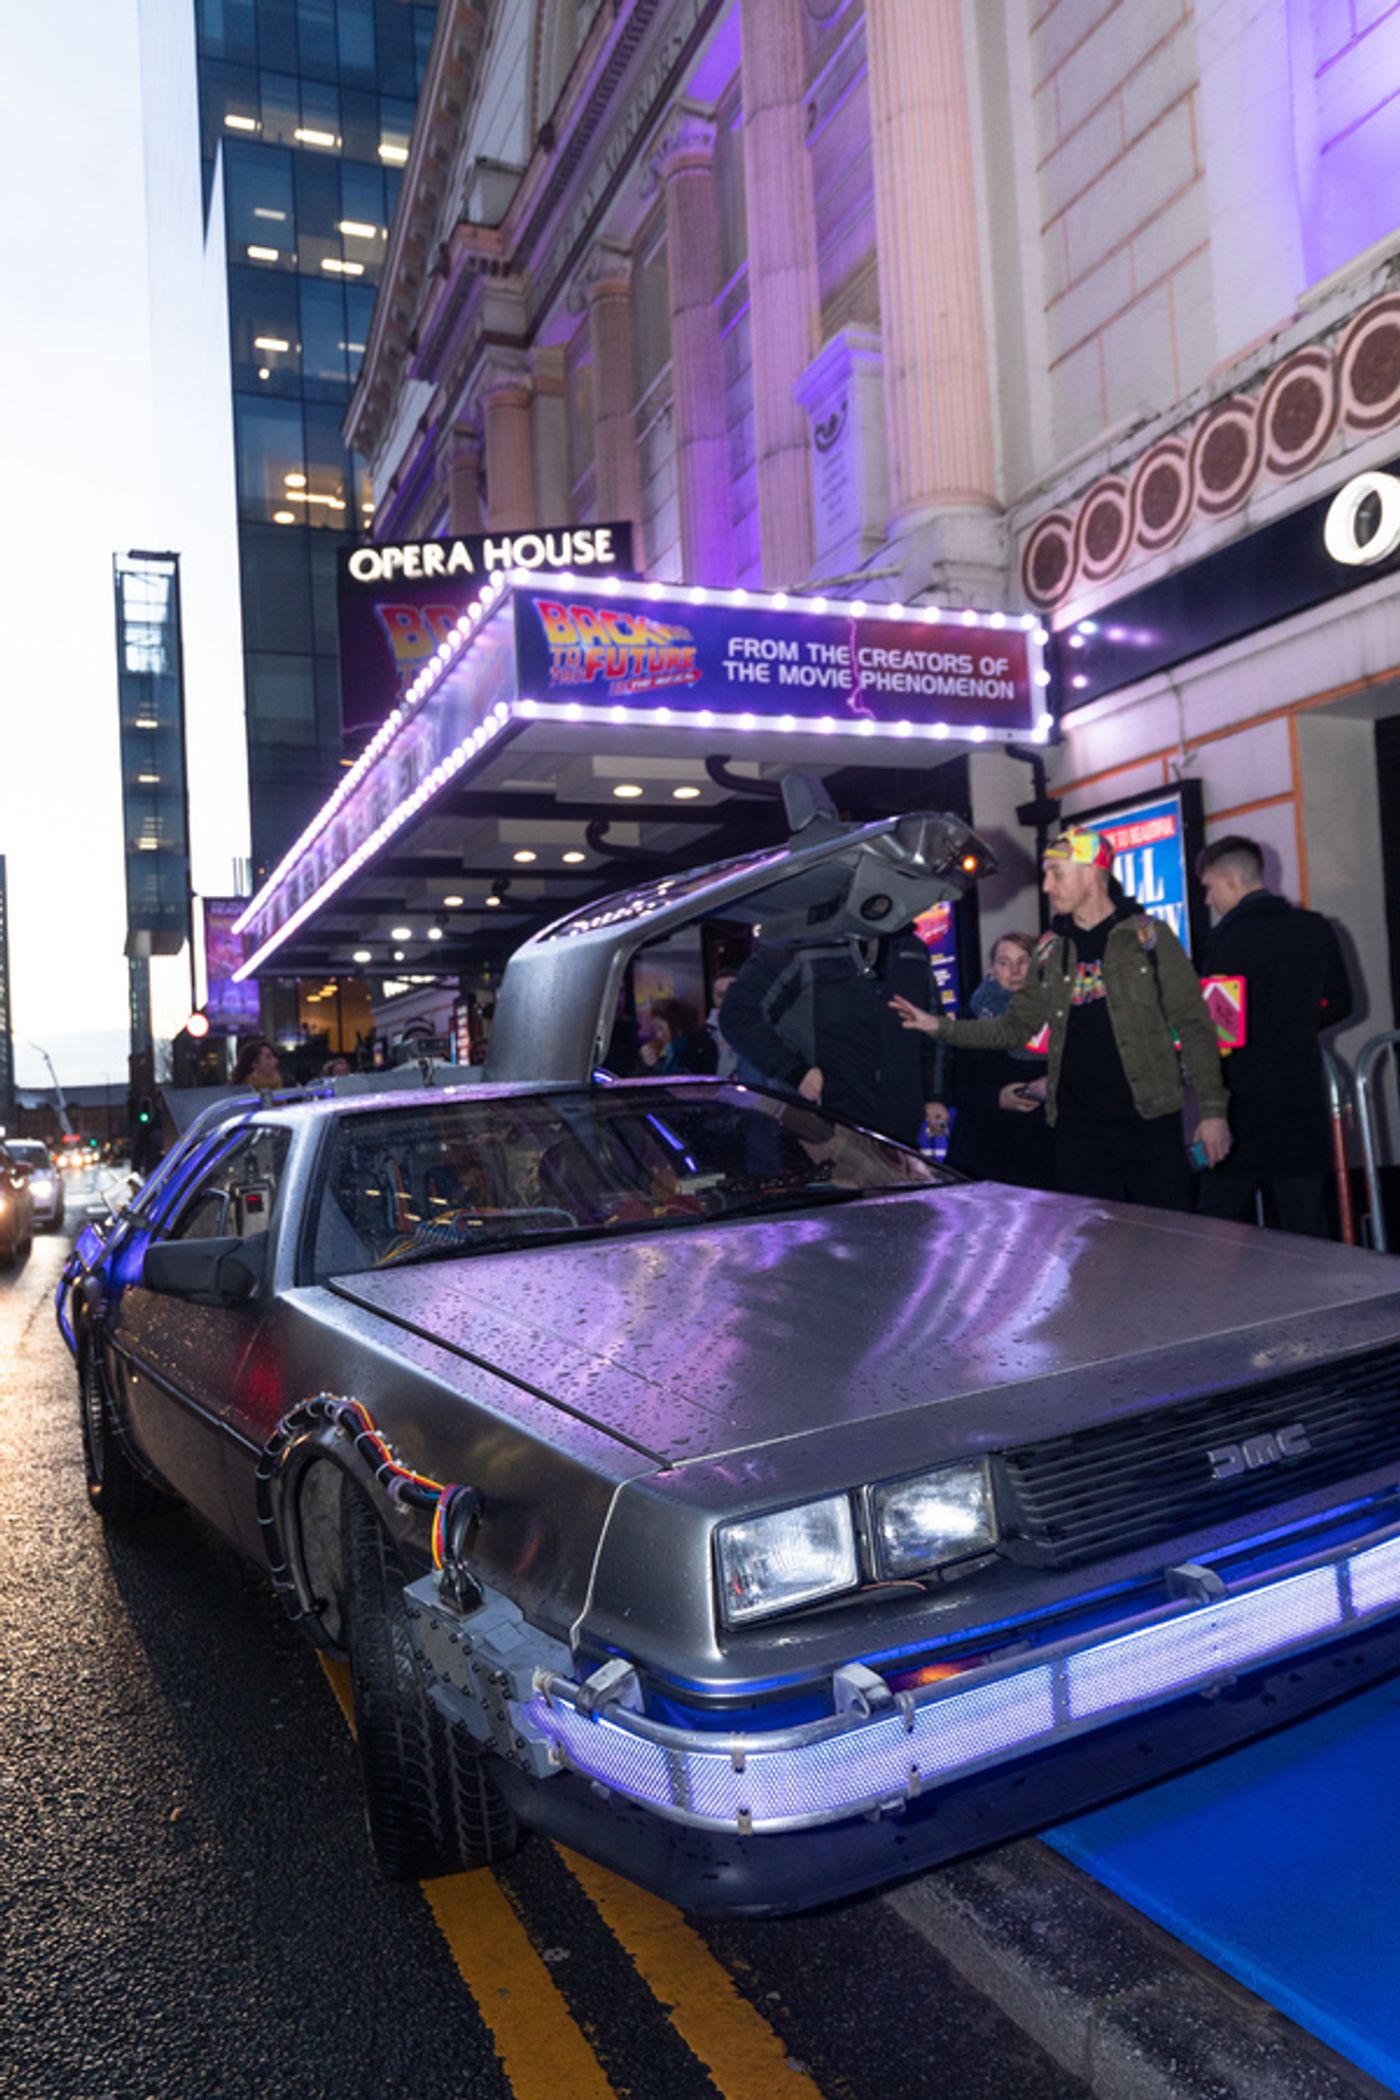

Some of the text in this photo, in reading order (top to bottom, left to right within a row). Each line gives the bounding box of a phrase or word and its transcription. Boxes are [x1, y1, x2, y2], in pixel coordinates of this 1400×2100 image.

[348, 529, 615, 582] OPERA HOUSE
[533, 598, 674, 646] BACK
[550, 646, 697, 682] TO FUTURE
[728, 637, 1010, 676] FROM THE CREATORS OF
[723, 660, 1015, 700] THE MOVIE PHENOMENON
[1207, 1423, 1313, 1481] DMC
